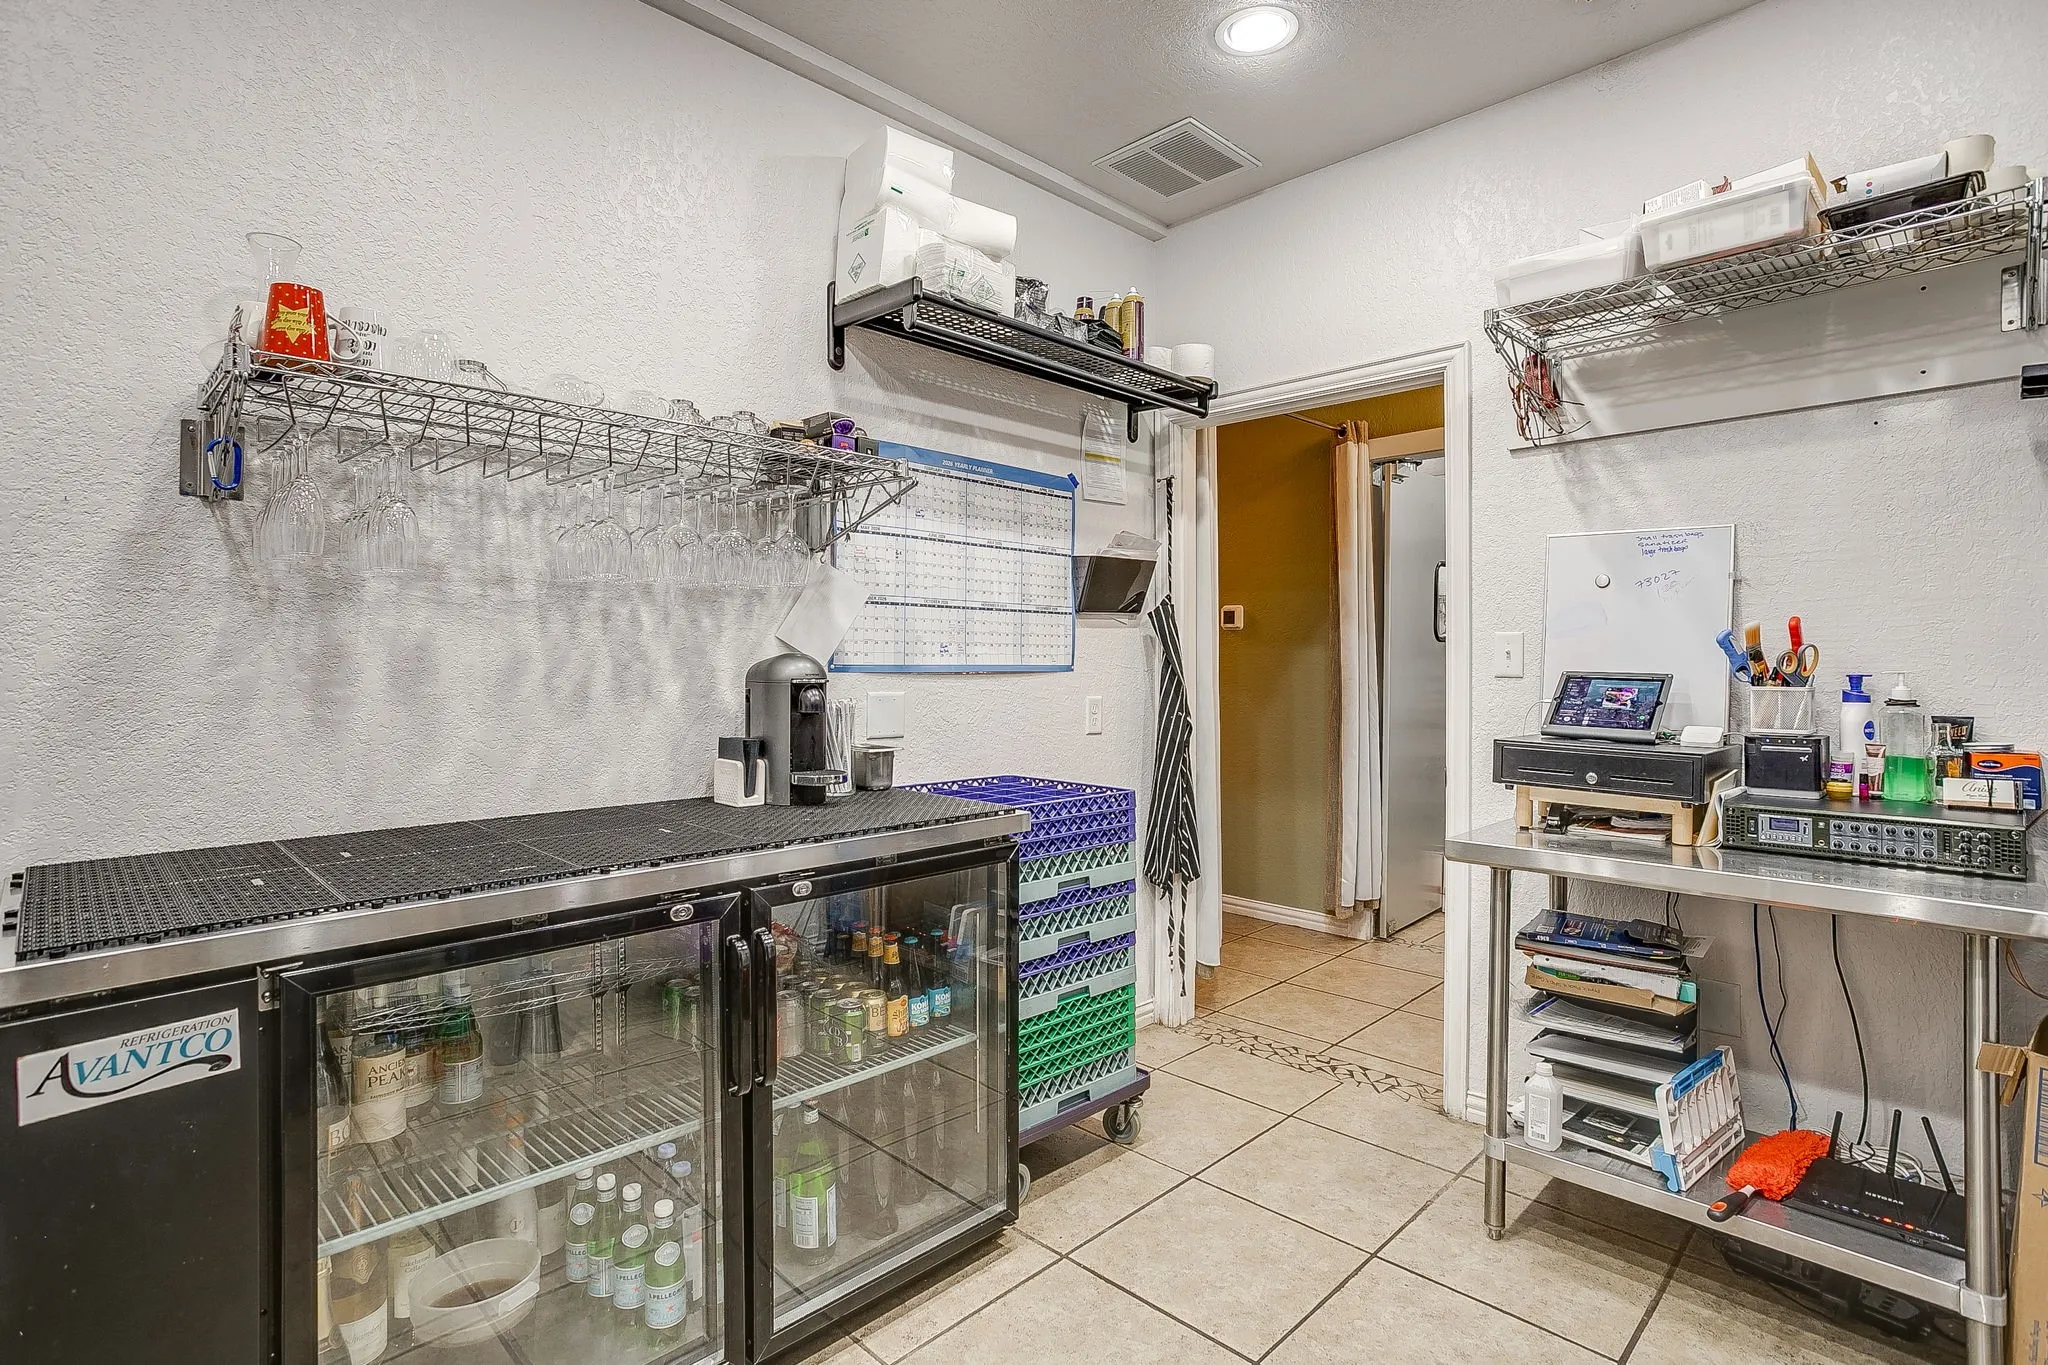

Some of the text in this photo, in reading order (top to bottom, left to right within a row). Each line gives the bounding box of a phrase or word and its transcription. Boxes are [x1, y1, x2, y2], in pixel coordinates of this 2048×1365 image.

[954, 461, 973, 470] YEARLY
[972, 465, 994, 474] PLANNER
[1634, 569, 1681, 589] 73027
[119, 1014, 233, 1050] REFRIGERATION
[25, 1027, 233, 1099] AVANTCO
[1864, 1190, 1905, 1206] NETGEAR
